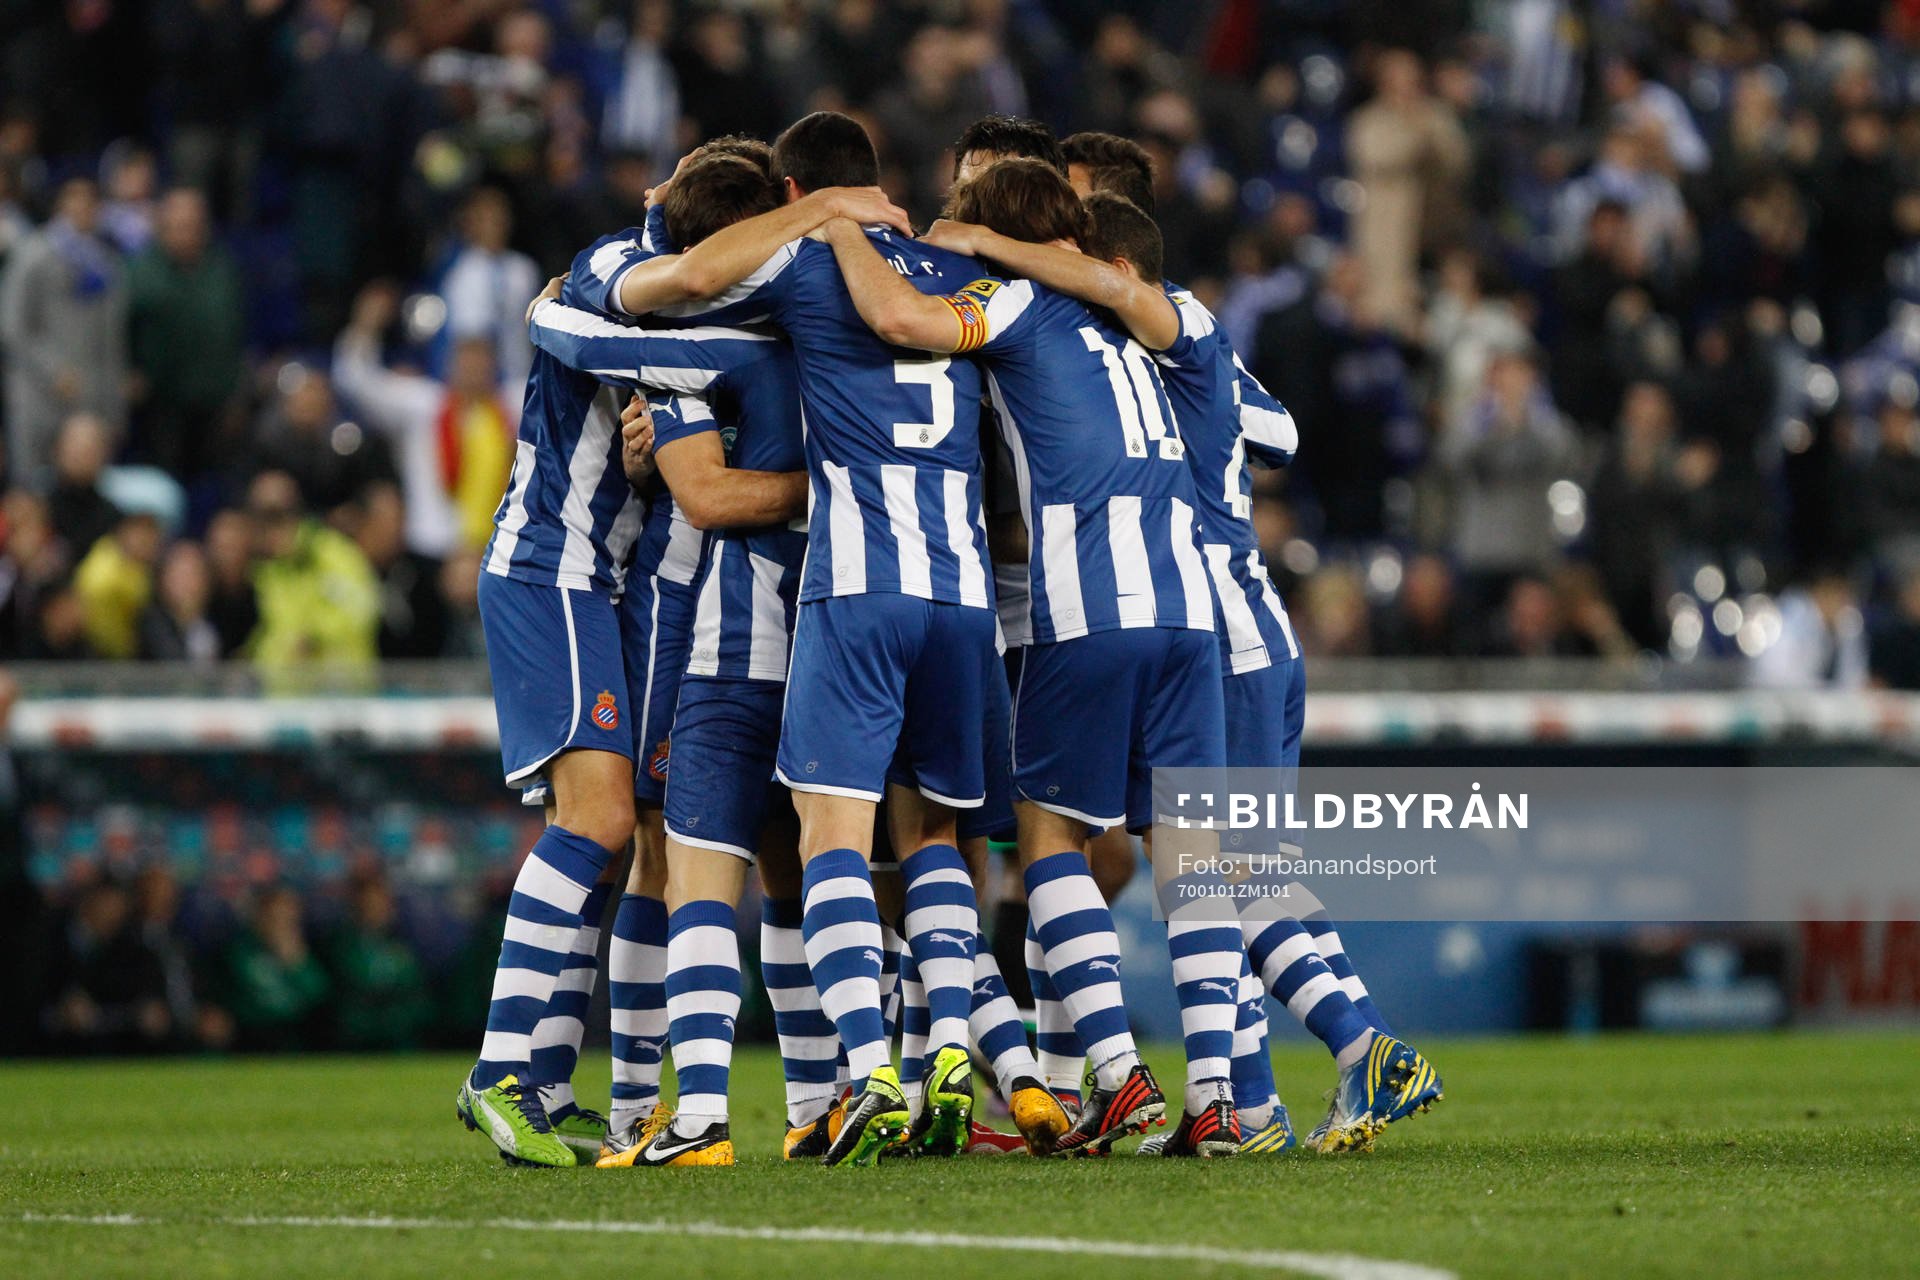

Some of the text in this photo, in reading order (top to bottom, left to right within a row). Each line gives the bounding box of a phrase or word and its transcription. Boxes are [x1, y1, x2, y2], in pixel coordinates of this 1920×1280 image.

[976, 281, 993, 292] 3
[893, 352, 955, 449] 3
[1078, 326, 1186, 461] 10
